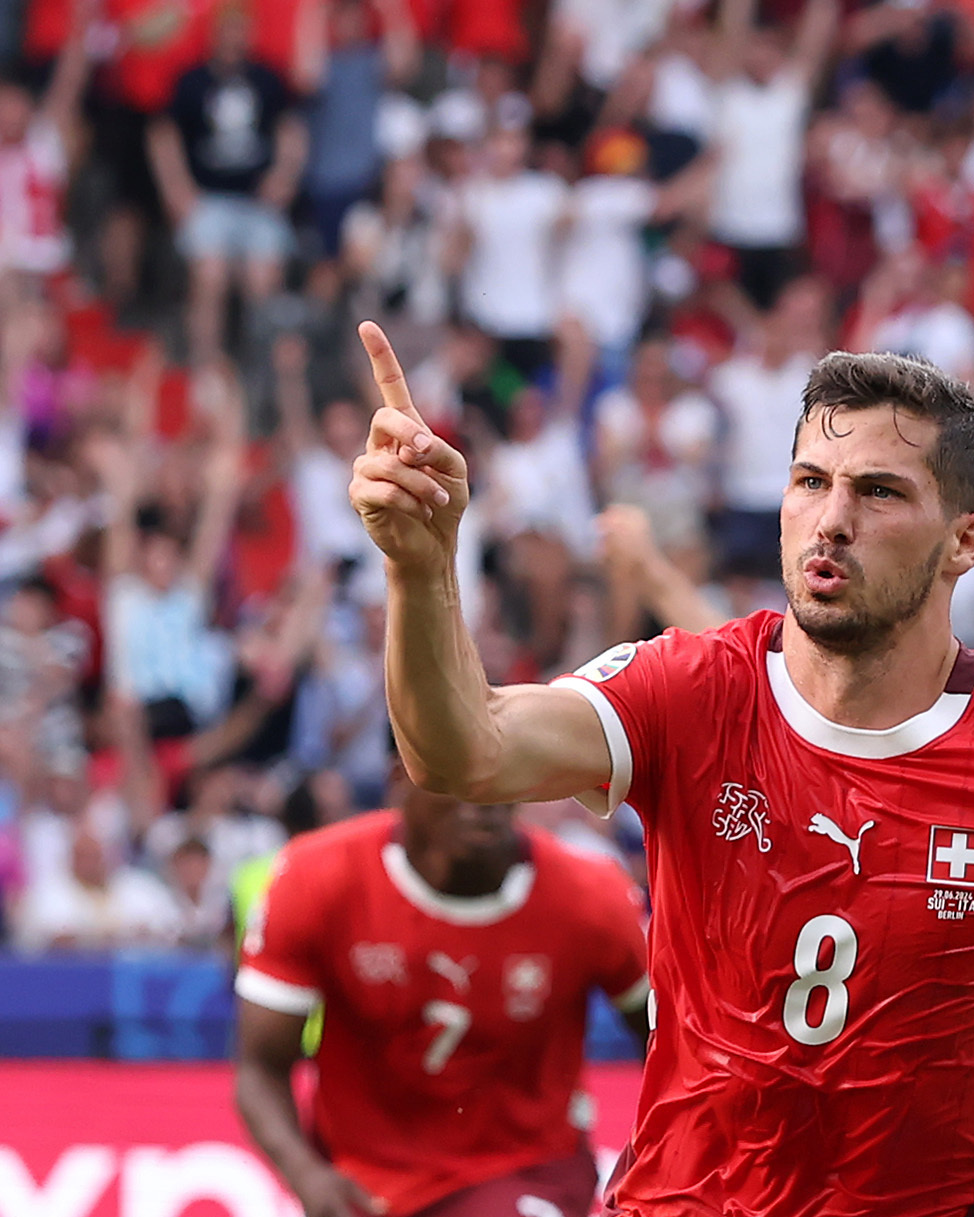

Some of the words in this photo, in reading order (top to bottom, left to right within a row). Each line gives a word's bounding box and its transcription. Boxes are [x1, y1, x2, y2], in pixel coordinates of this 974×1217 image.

[927, 897, 946, 910] SUI
[937, 911, 964, 920] BERLIN
[784, 914, 857, 1046] 8
[421, 999, 474, 1076] 7
